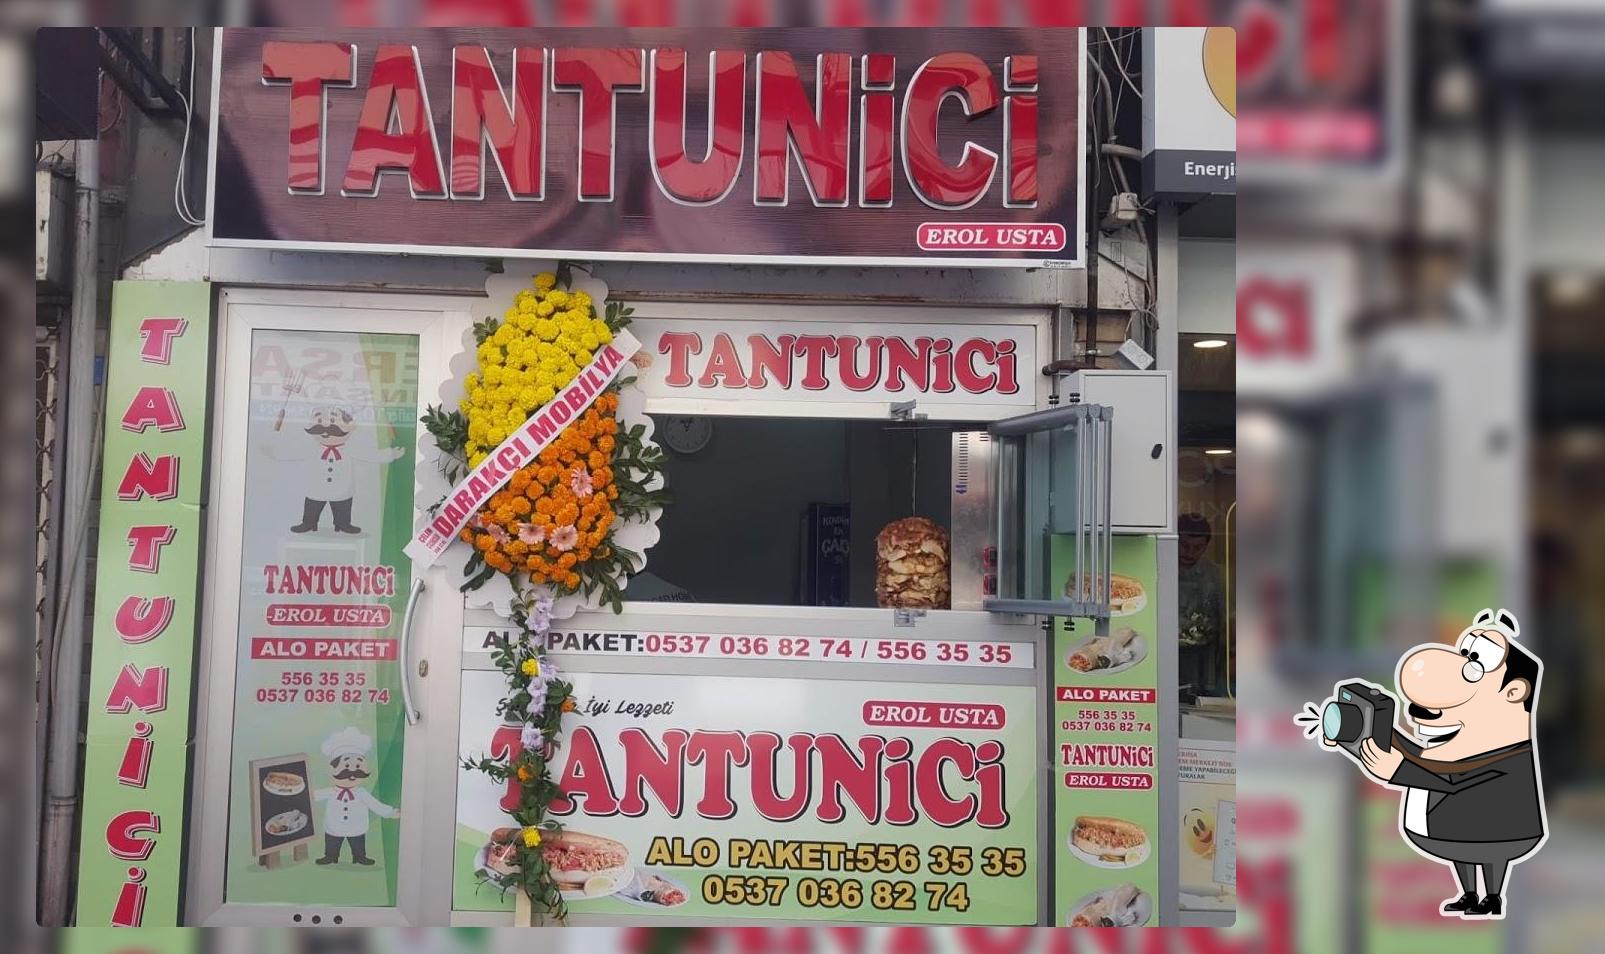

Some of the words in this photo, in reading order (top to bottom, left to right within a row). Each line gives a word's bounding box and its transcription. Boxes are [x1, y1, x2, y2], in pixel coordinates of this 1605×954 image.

[1184, 161, 1236, 180] Enerji
[925, 228, 989, 245] EROL
[996, 229, 1058, 246] USTA
[432, 437, 531, 538] DARAKÇI
[526, 345, 624, 446] MOBİLYA
[333, 609, 385, 624] USTA
[260, 641, 307, 657] ALO
[314, 641, 390, 657] PAKET
[719, 636, 770, 655] 036
[777, 638, 811, 656] 82
[819, 639, 853, 658] 74
[861, 640, 868, 658] /
[876, 641, 927, 661] 556
[936, 643, 969, 662] 35
[979, 645, 1012, 664] 35
[282, 672, 313, 686] 556
[319, 672, 339, 686] 35
[345, 673, 366, 686] 35
[256, 689, 298, 703] 0537
[304, 689, 335, 703] 036
[341, 690, 362, 703] 82
[368, 690, 389, 704] 74
[1062, 689, 1095, 700] ALO
[1099, 690, 1150, 701] PAKET
[869, 705, 931, 723] EROL
[939, 707, 999, 726] USTA
[1078, 710, 1100, 720] 556
[1103, 710, 1118, 720] 35
[1121, 711, 1136, 721] 35
[1062, 721, 1090, 731] 0537
[1094, 722, 1116, 731] 036
[1119, 722, 1134, 732] 82
[1137, 723, 1152, 732] 74
[1069, 775, 1107, 786] EROL
[1112, 776, 1149, 787] USTA
[645, 836, 720, 867] ALO
[927, 844, 973, 876] 35
[980, 847, 1027, 878] 35
[701, 873, 789, 906] 0537
[796, 876, 864, 909] 036
[871, 879, 917, 911] 82
[924, 882, 970, 912] 74
